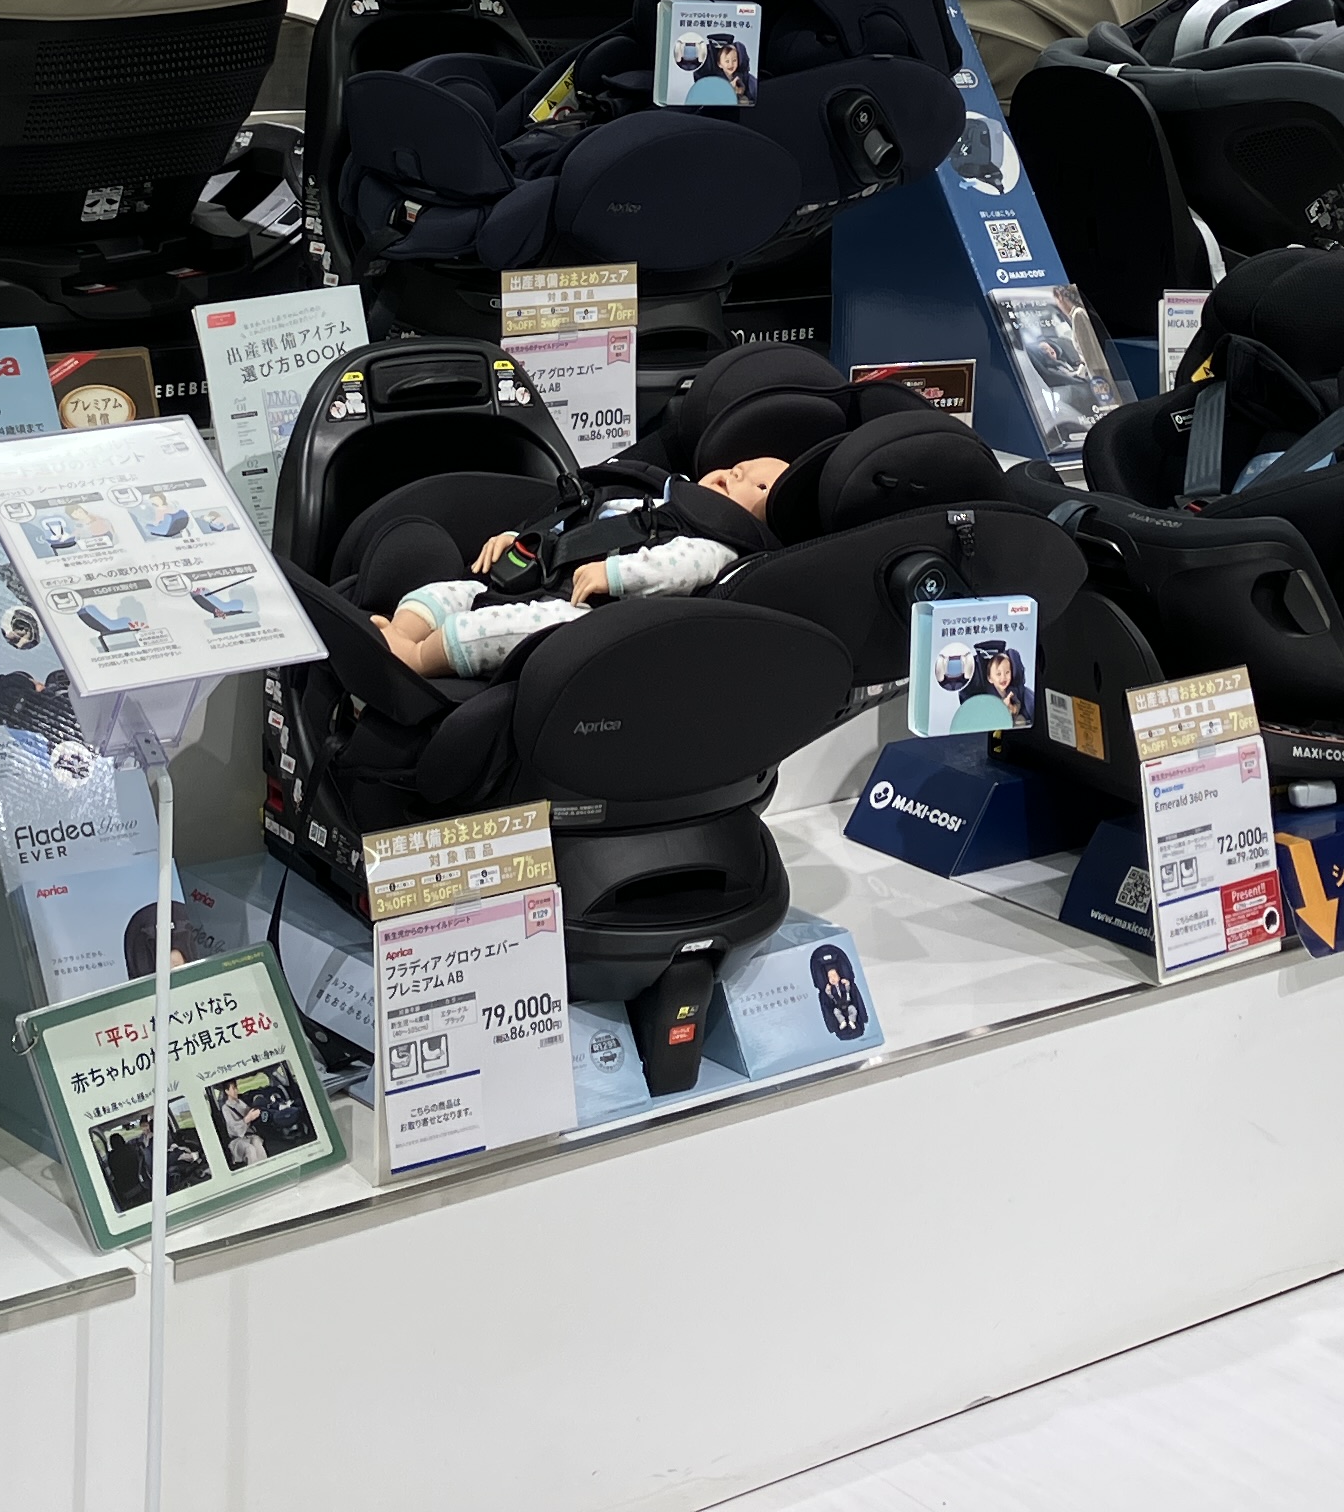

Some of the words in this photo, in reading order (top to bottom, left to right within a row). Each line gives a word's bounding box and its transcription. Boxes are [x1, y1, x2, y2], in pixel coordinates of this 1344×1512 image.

[510, 269, 629, 291] 出産準備おまとめフェア
[226, 320, 352, 366] 出産準備アイテム
[241, 341, 348, 384] 選び方BOOK
[548, 367, 574, 379] グロウ
[578, 364, 603, 375] エバー
[70, 397, 122, 412] プレミアム
[571, 408, 631, 430] 79,000円
[84, 557, 204, 582] 車への取り付け方で選ぶ
[1135, 674, 1241, 711] 出産準備おまとめフェア
[1155, 794, 1188, 813] Emerald
[14, 814, 97, 851] Fladea
[376, 810, 538, 858] 出産準備おまとめフェア
[19, 845, 68, 865] EVER
[36, 884, 69, 899] Aprica
[386, 946, 414, 961] Aprica
[386, 955, 442, 980] フラディア
[444, 947, 482, 968] グロウ
[485, 940, 520, 959] エバー
[387, 976, 445, 1000] プレミアム
[448, 972, 465, 986] AB
[482, 992, 562, 1030] 79,000円
